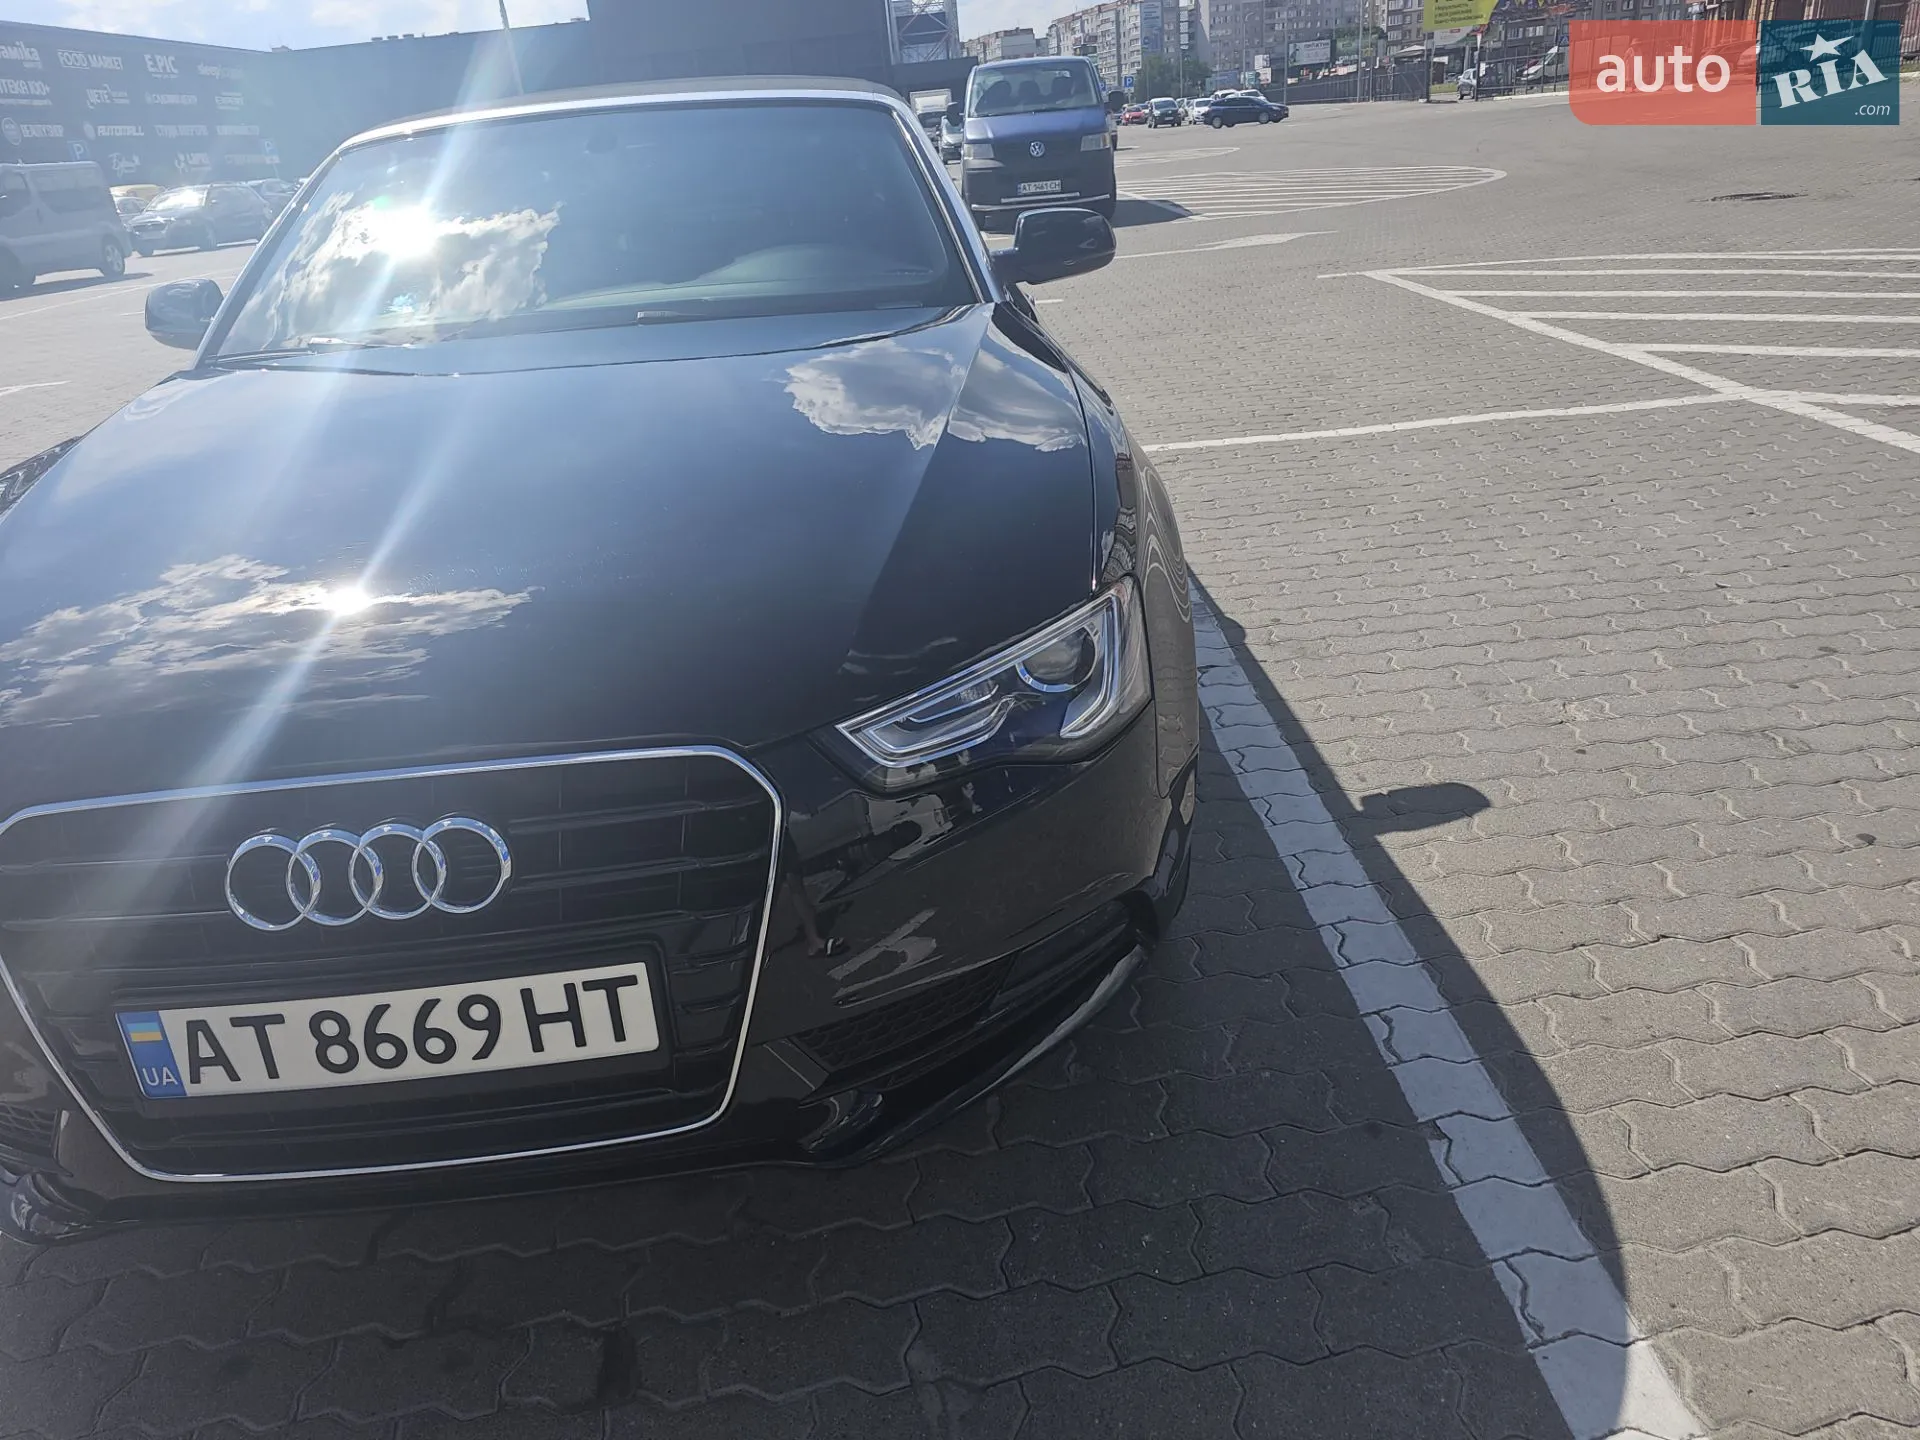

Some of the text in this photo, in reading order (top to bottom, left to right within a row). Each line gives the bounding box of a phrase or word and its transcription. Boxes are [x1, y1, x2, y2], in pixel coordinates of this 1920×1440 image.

[57, 51, 89, 67] FOOD
[88, 53, 123, 70] MARKET
[185, 974, 639, 1085] AT 8669 HT
[144, 1067, 178, 1089] UA
